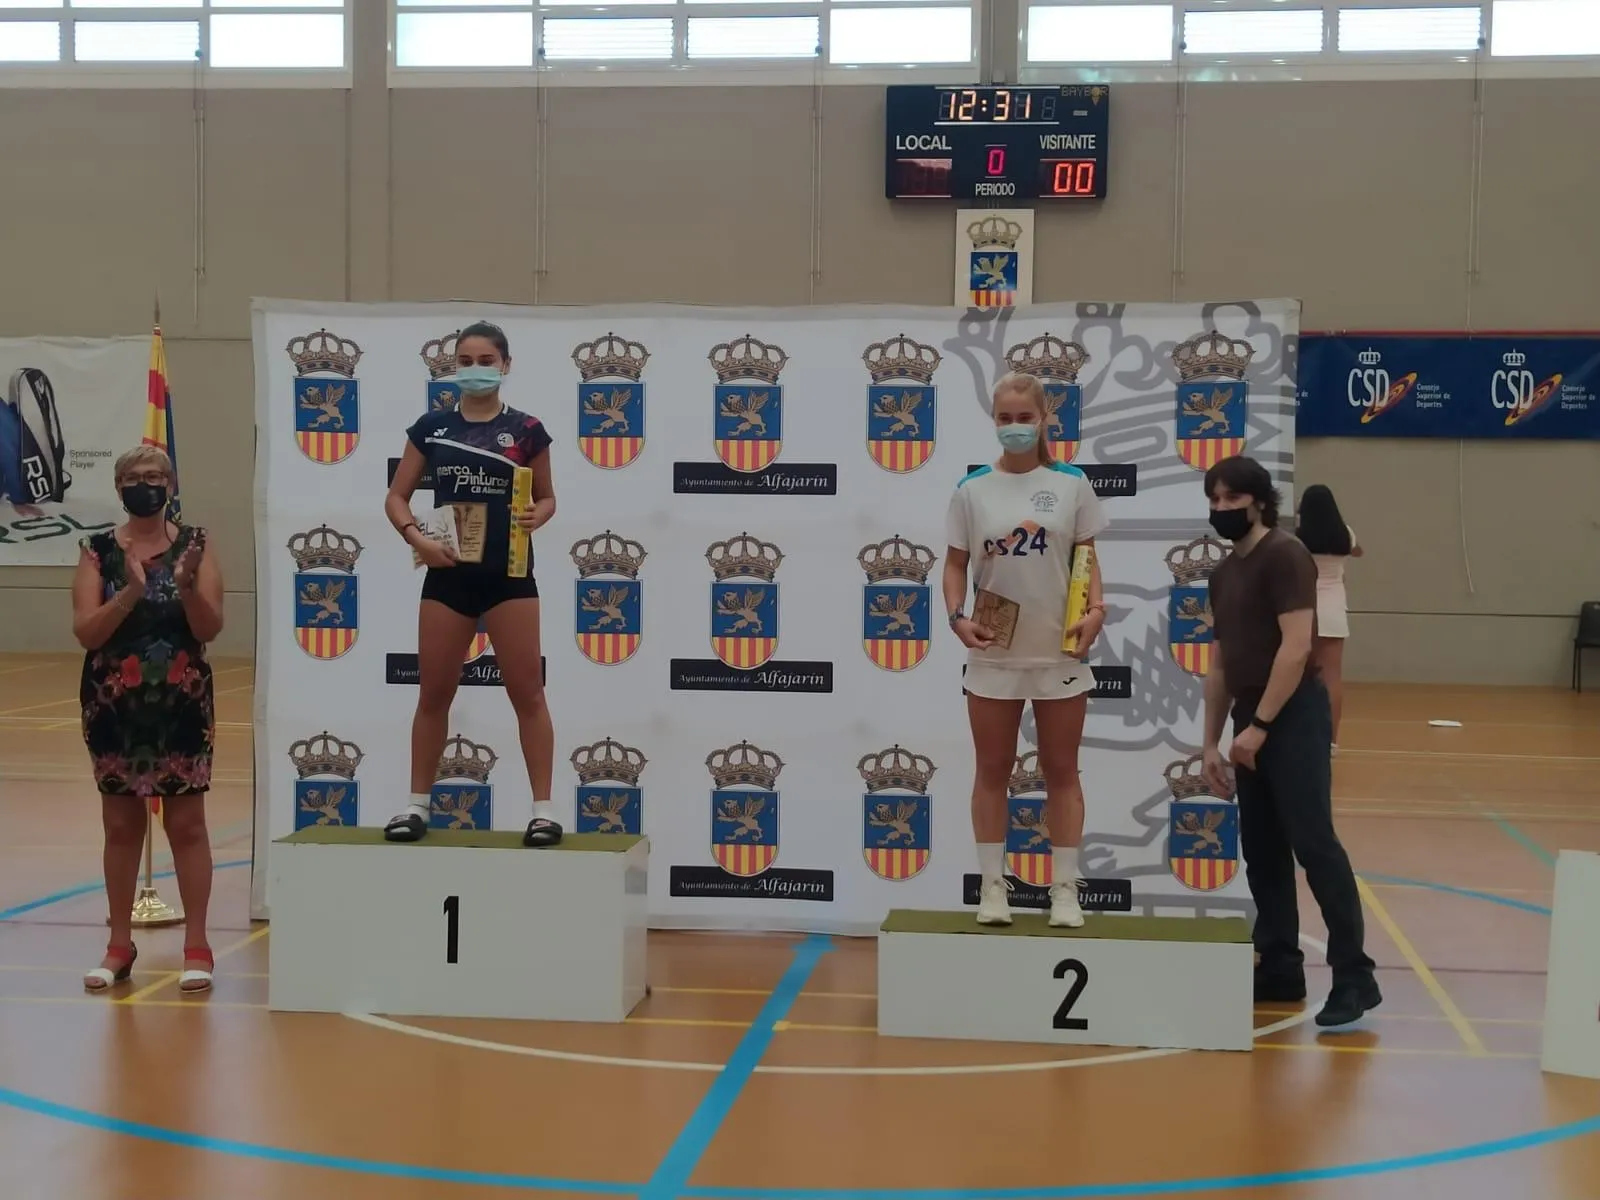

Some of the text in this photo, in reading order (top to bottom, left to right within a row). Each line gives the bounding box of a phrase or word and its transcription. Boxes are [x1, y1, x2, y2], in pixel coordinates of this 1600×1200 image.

[896, 135, 952, 150] LOCAL
[1040, 134, 1096, 150] VISITANTE
[988, 149, 1005, 175] 0
[1054, 163, 1094, 193] 00
[975, 183, 1016, 196] PERIODO
[1348, 368, 1390, 408] CSD
[1491, 369, 1534, 409] CSD
[1416, 391, 1442, 401] Superior
[1416, 400, 1443, 409] Deportes
[70, 449, 112, 459] Sponsored
[70, 460, 95, 469] Player
[680, 477, 742, 488] Ayuntamiento
[679, 674, 739, 684] Ayuntamiento
[443, 895, 459, 964] 1
[1053, 958, 1088, 1030] 2
